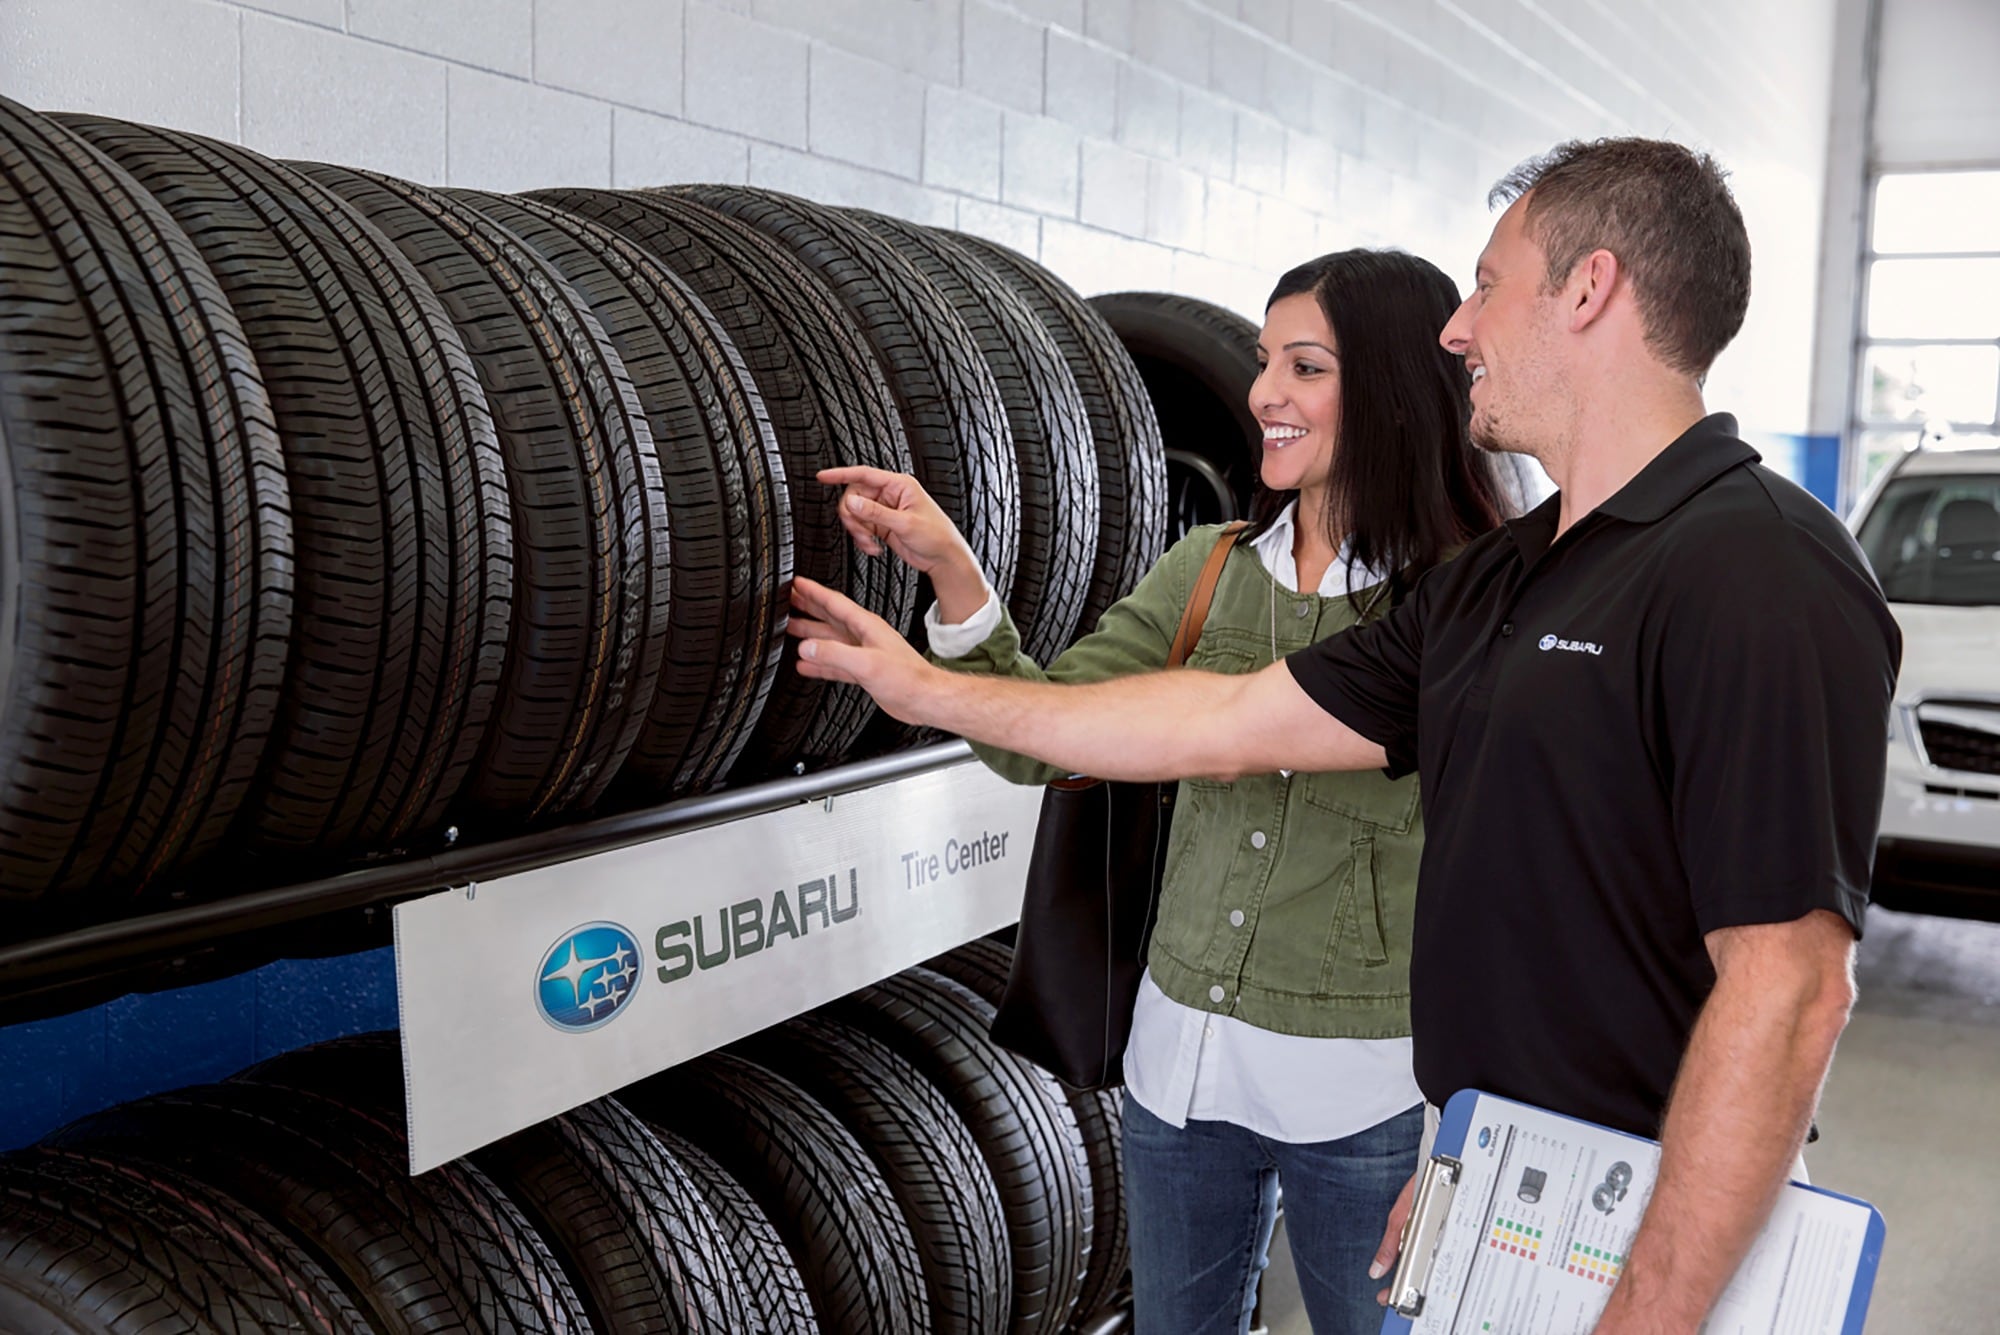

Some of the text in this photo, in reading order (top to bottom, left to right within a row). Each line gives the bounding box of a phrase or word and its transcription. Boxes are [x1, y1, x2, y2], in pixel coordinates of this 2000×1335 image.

[1556, 639, 1603, 656] SUBARU
[902, 830, 1009, 890] Tire Center
[655, 867, 858, 984] SUBARU
